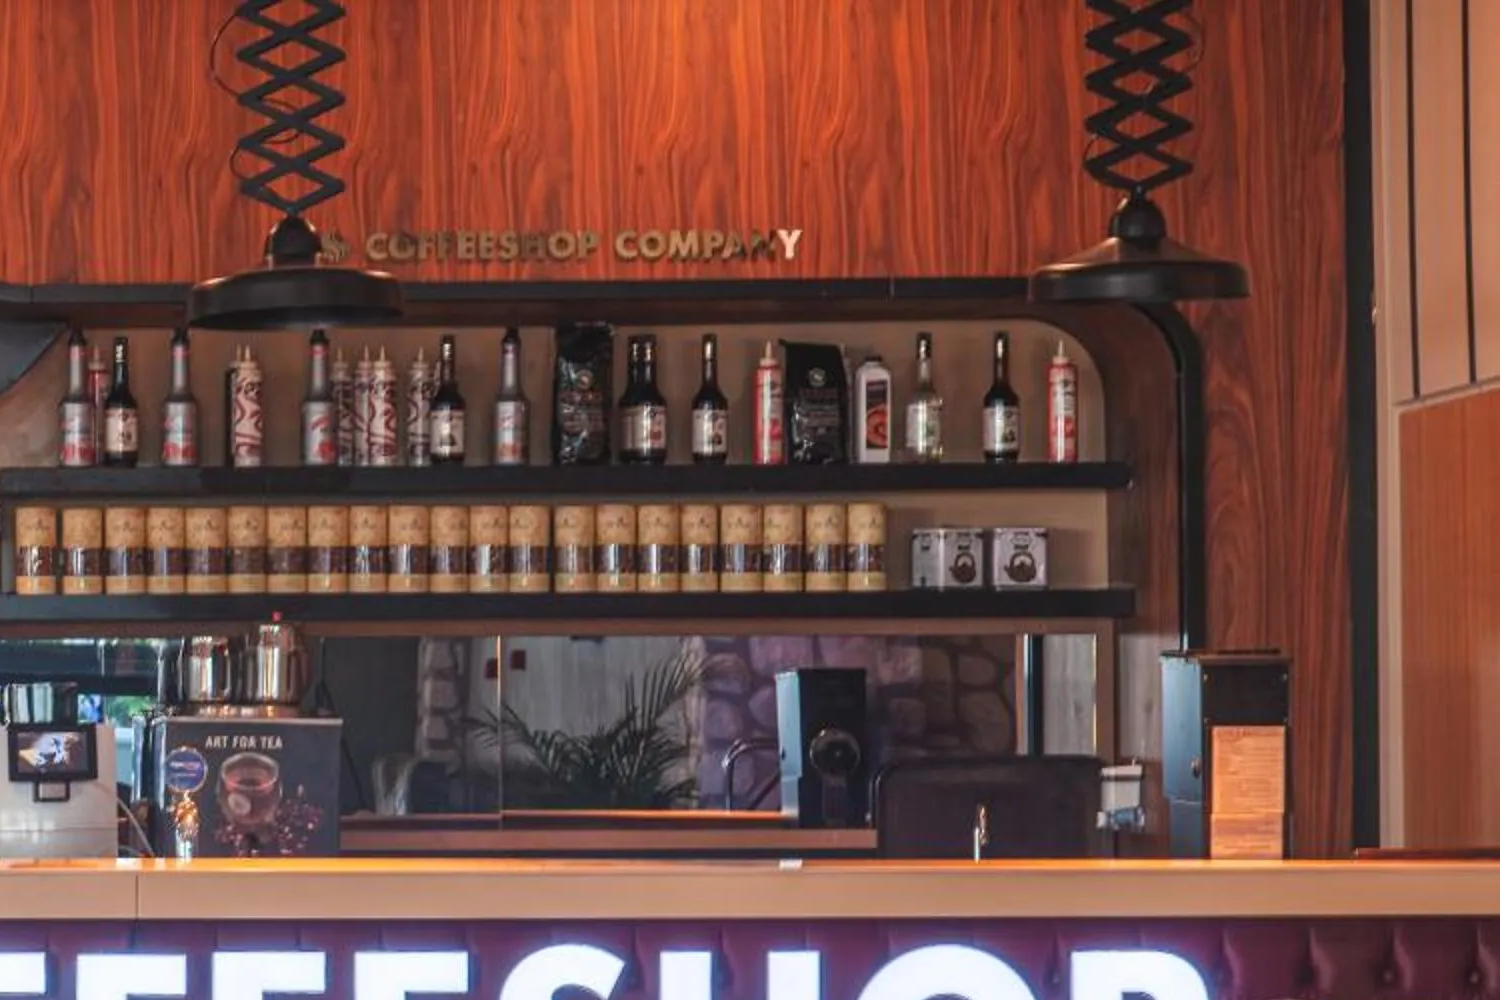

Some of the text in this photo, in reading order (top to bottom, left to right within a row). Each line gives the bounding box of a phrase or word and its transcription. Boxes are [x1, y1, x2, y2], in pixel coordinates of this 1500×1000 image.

[366, 228, 803, 261] COFFEESHOP COMPANY
[205, 735, 228, 749] ART
[260, 735, 283, 749] TEA
